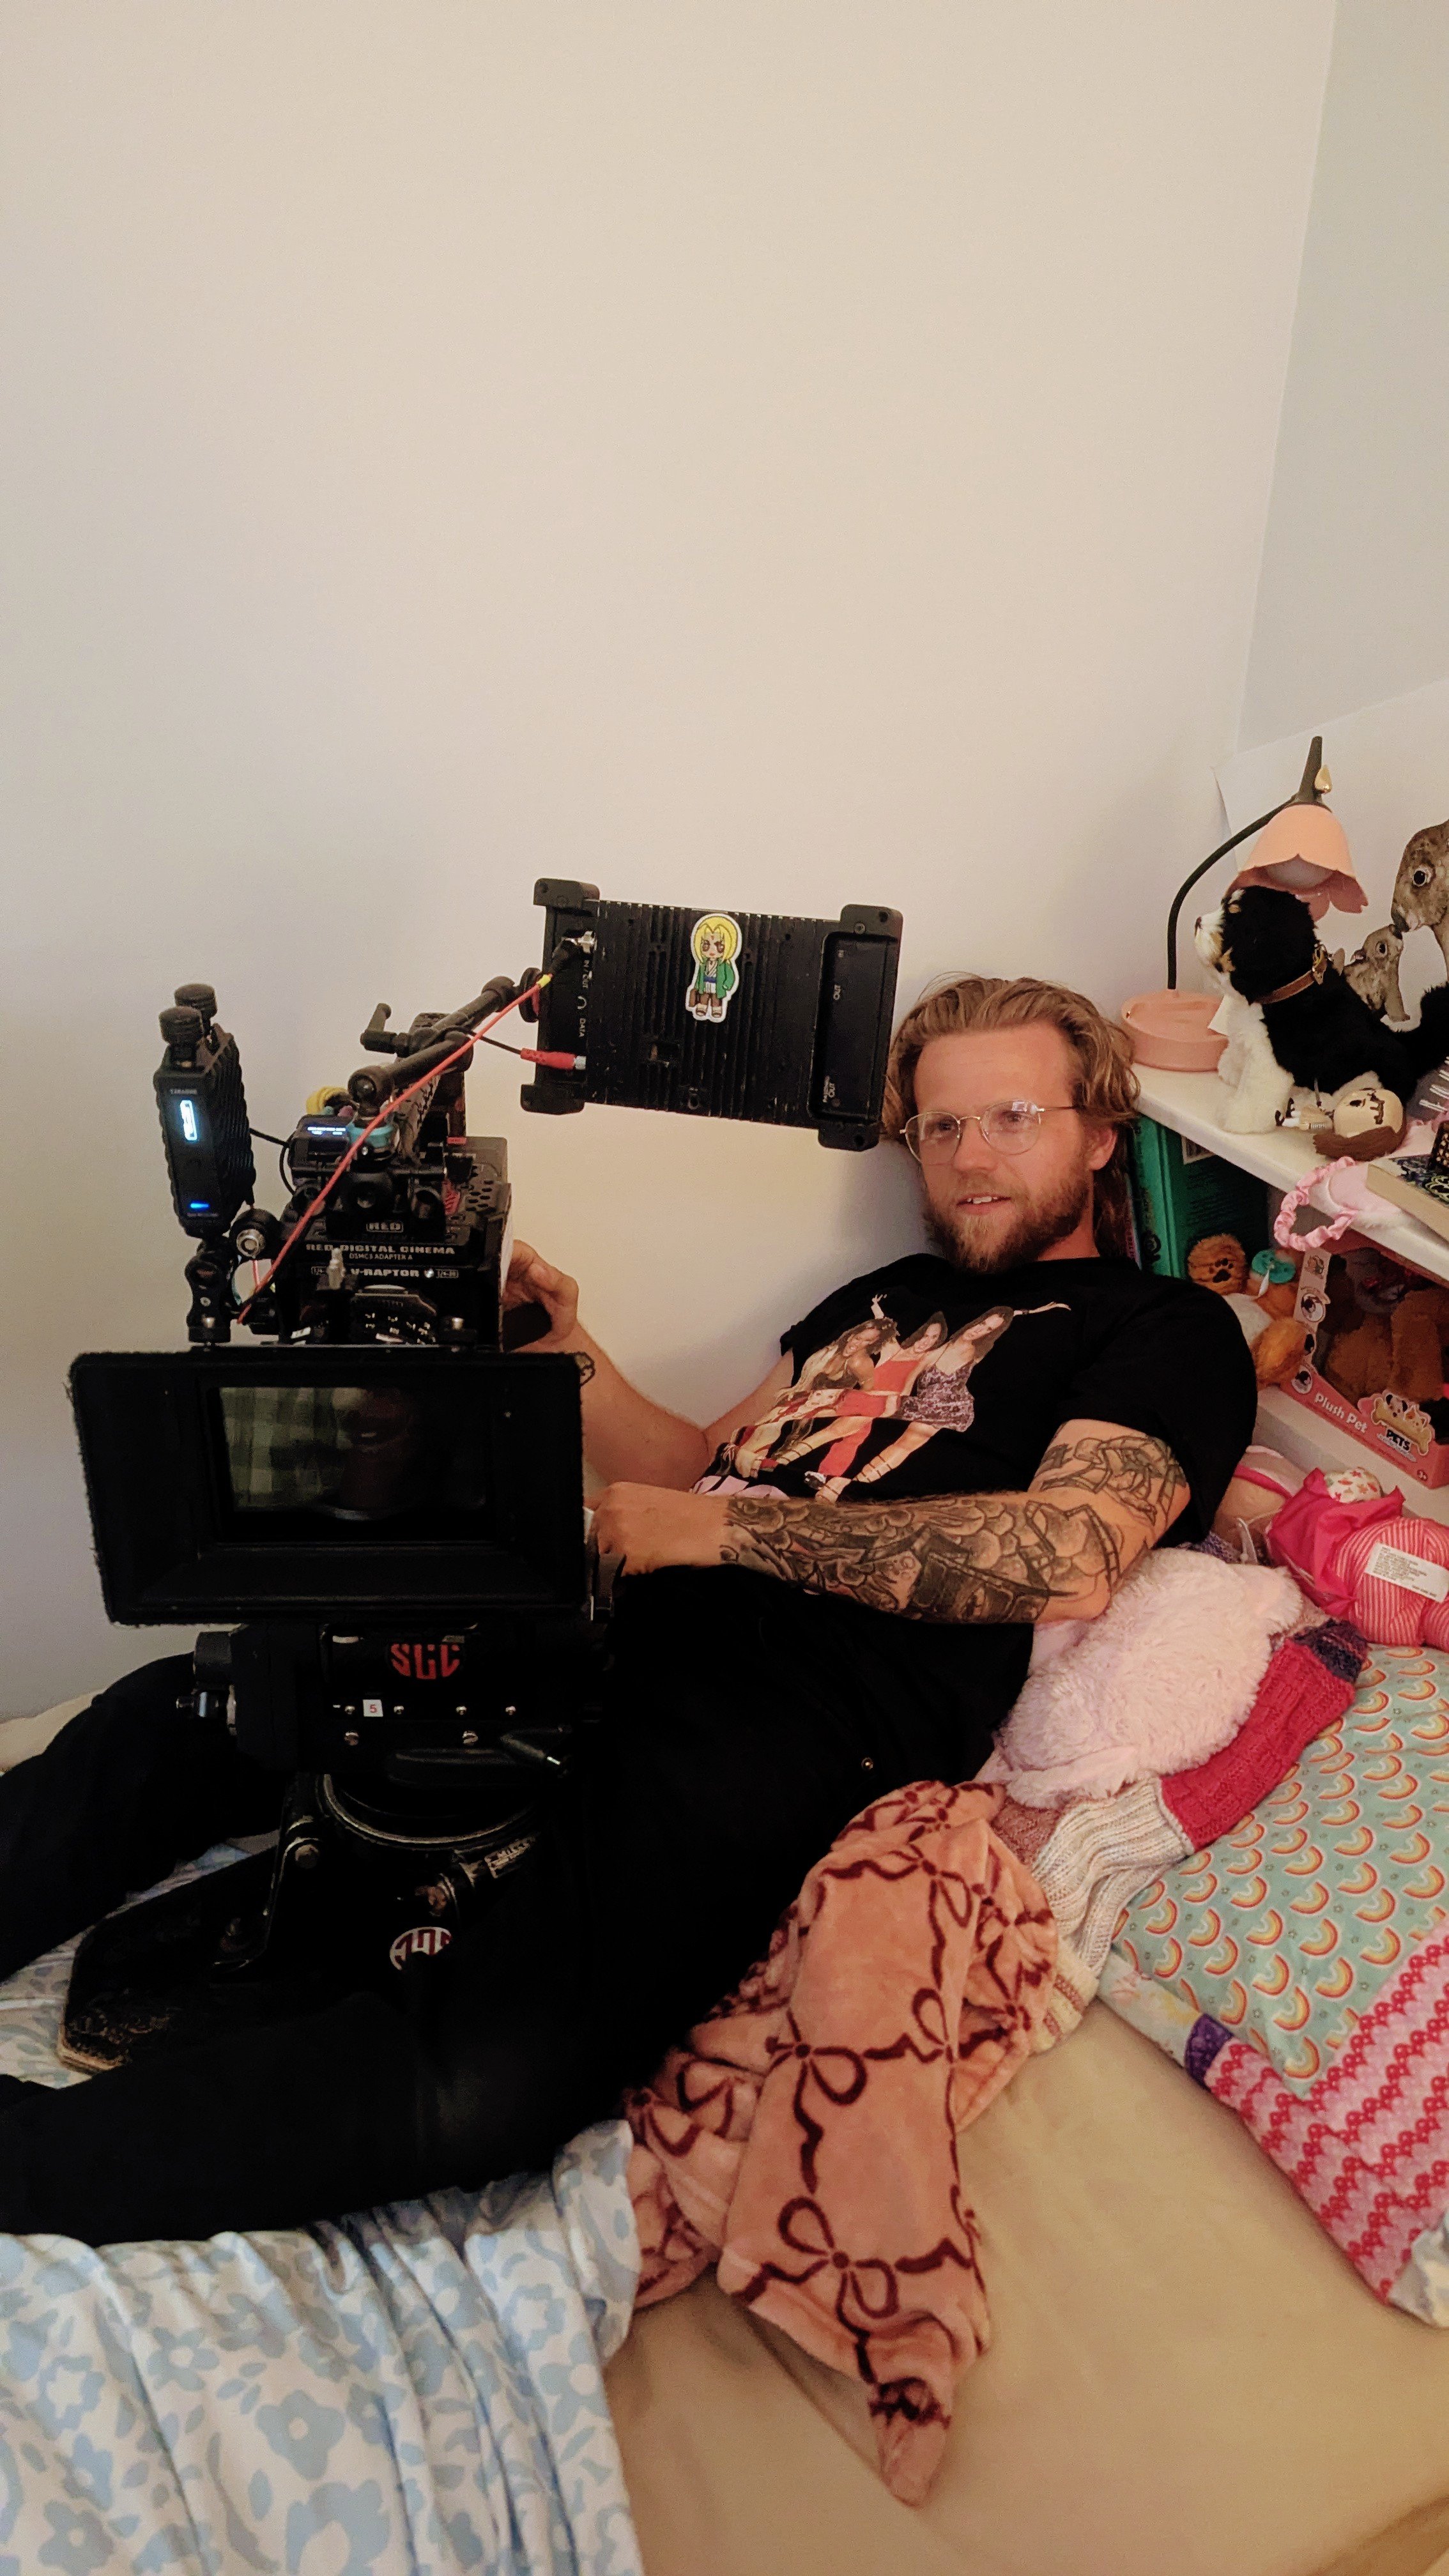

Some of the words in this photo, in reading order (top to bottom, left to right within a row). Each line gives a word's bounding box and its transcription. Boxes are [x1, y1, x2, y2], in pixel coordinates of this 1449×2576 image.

[832, 984, 842, 1001] OUT
[305, 1243, 334, 1252] RED
[339, 1244, 397, 1254] DIGITAL
[399, 1245, 456, 1255] CINEMA
[350, 1268, 420, 1278] V-RAPTOR
[1314, 1393, 1346, 1420] Plush
[1346, 1413, 1368, 1434] Pet
[1386, 1429, 1411, 1452] PETS
[369, 1703, 378, 1713] 5
